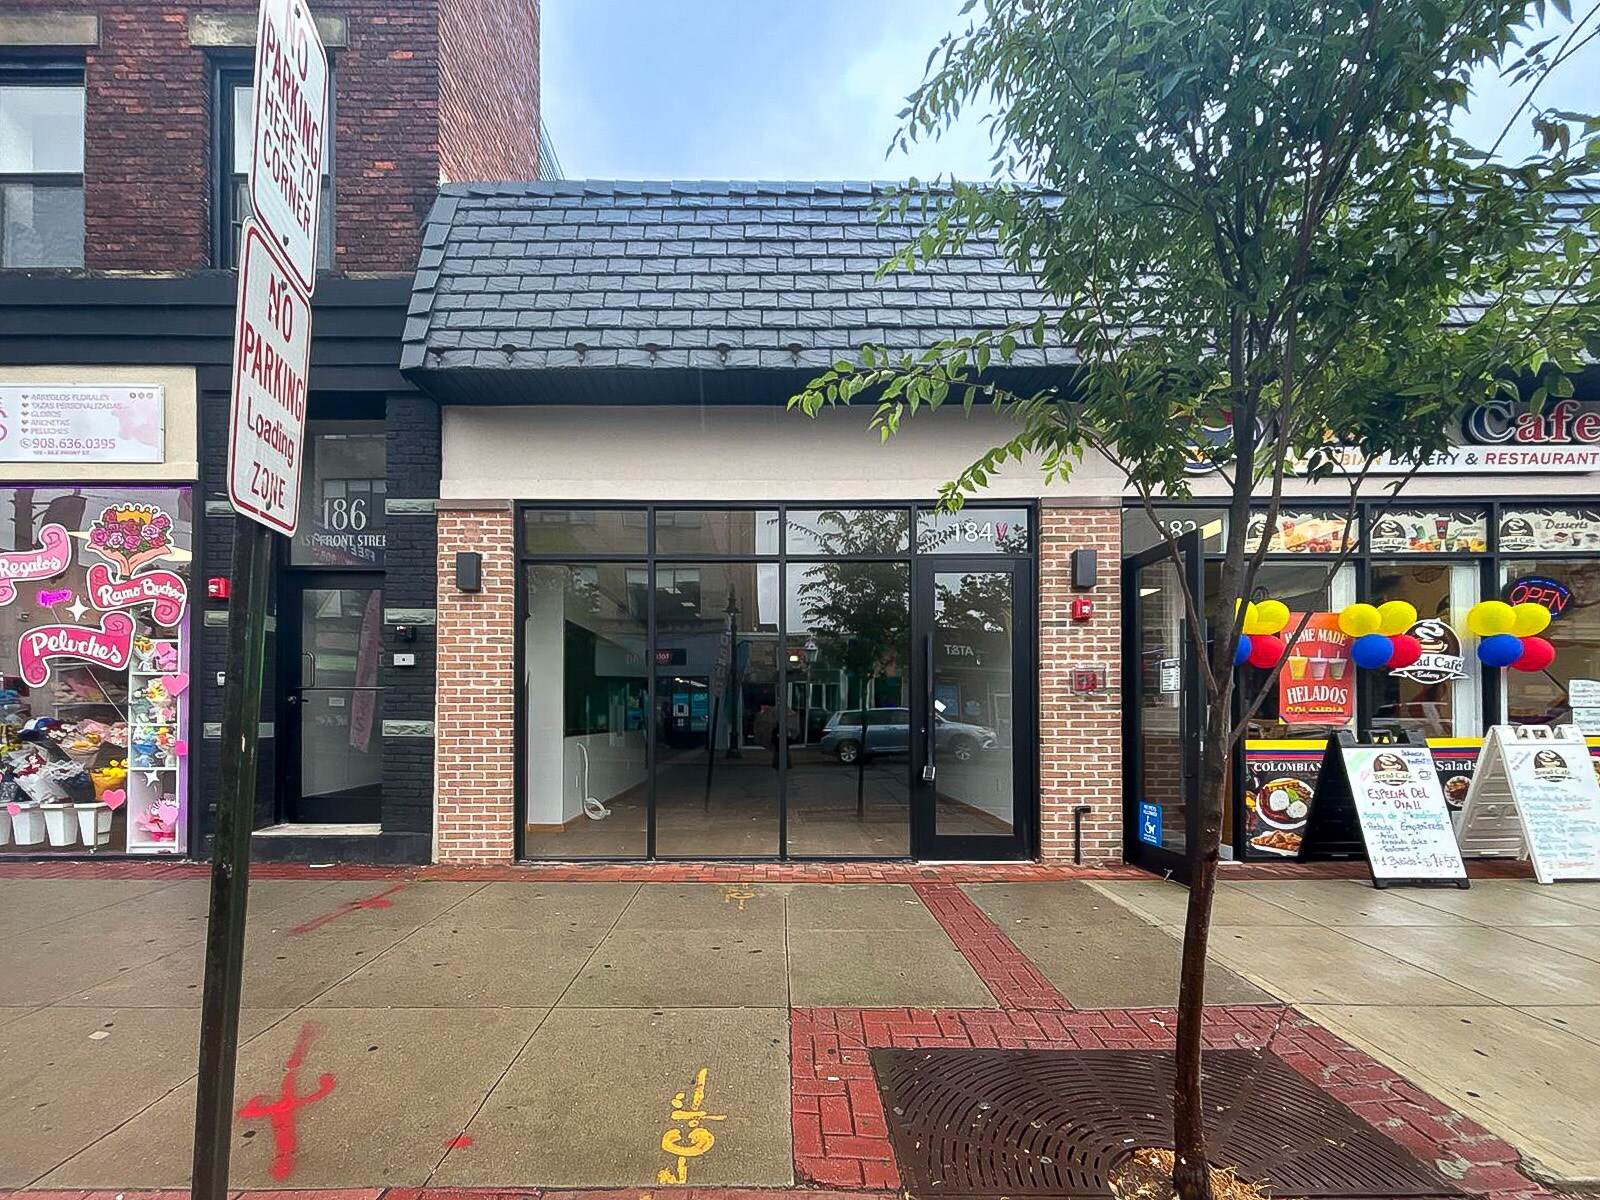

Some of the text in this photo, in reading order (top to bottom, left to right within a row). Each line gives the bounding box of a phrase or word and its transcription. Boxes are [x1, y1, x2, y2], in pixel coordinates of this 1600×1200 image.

[285, 0, 308, 82] NO
[265, 14, 319, 170] PARKING
[265, 81, 313, 201] HERE TO
[263, 129, 310, 240] CORNER
[267, 272, 293, 343] NO
[242, 321, 303, 422] PARKING
[32, 438, 116, 449] 908.636.0395
[246, 396, 294, 469] Loading
[1389, 452, 1459, 466] BAERY
[1465, 452, 1478, 465] &
[1485, 452, 1600, 465] RESTAURANT
[250, 461, 286, 510] ZONE
[322, 498, 366, 530] 186
[1541, 519, 1589, 530] Desserts
[0, 554, 62, 578] Regalos
[97, 584, 141, 606] Ramo
[1510, 585, 1571, 612] OPEN
[26, 629, 122, 664] Peluches
[1285, 628, 1348, 646] HME MADE
[1286, 685, 1348, 705] HELADOS
[1435, 760, 1478, 771] Salads
